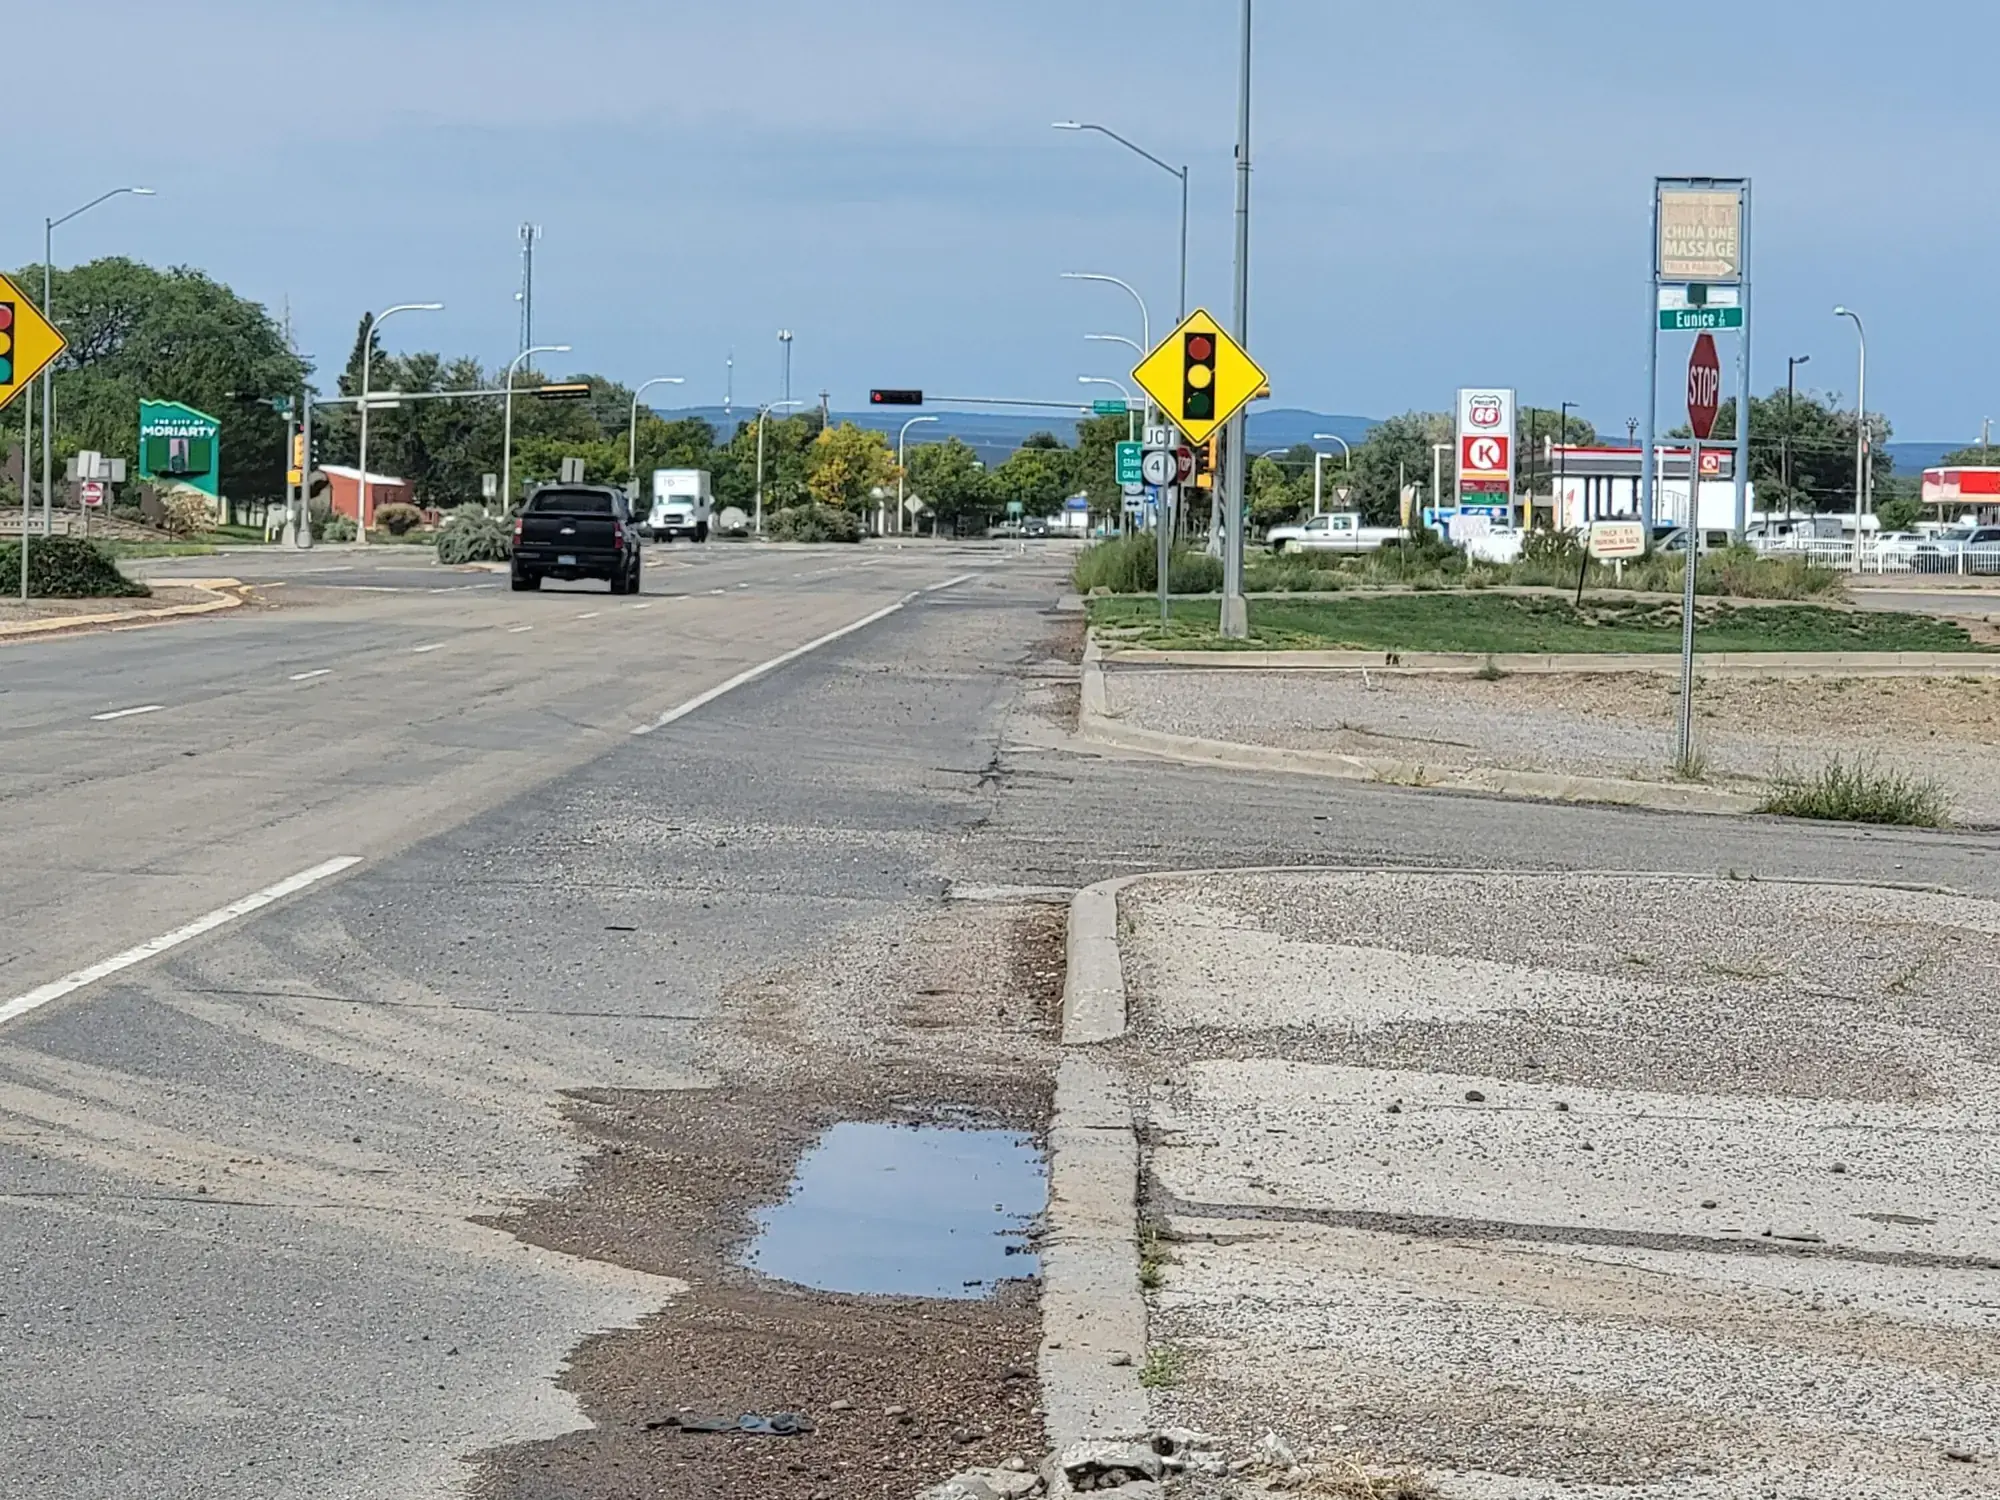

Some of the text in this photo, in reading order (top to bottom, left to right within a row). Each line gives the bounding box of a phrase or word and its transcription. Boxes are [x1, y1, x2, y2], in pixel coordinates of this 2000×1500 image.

[1664, 225, 1736, 240] CHINA ONE
[1664, 240, 1735, 257] MASSAGE
[1676, 310, 1715, 328] Eunice
[1689, 366, 1718, 407] STOP
[1474, 408, 1498, 422] 66
[141, 425, 216, 437] MORIARTY
[1479, 444, 1497, 465] K
